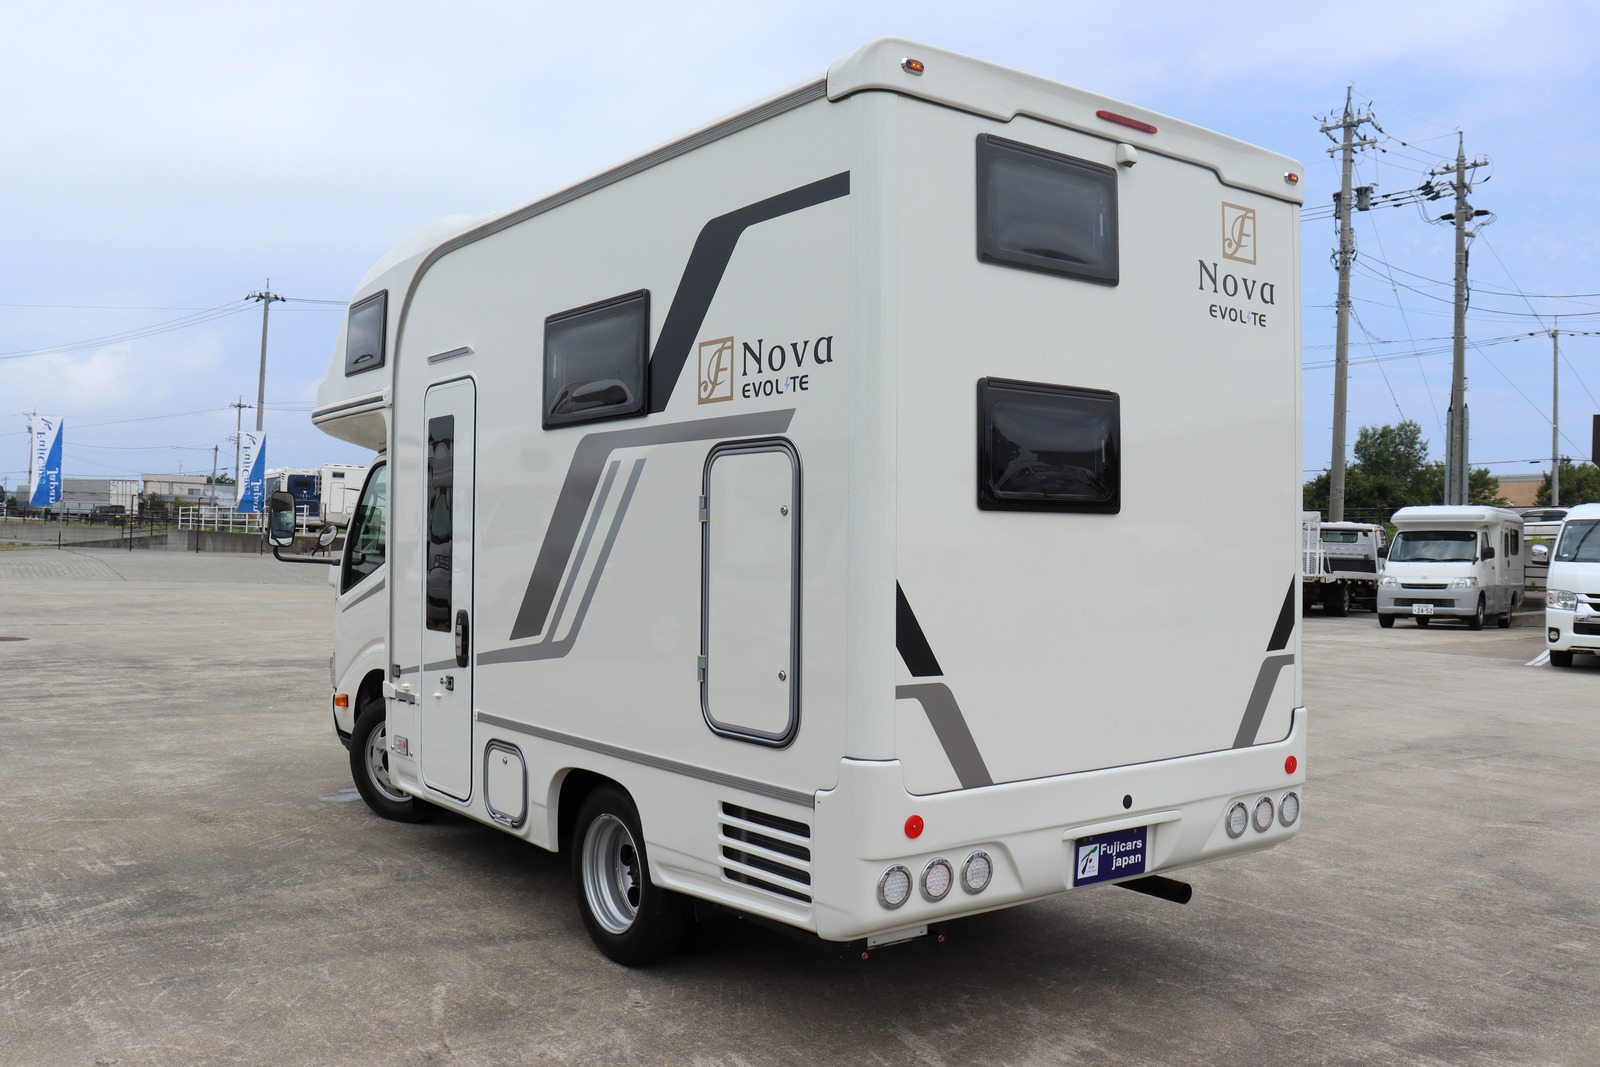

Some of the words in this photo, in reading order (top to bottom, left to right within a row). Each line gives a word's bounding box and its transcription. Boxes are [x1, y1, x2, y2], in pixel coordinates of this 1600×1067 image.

[1198, 260, 1274, 305] Nova
[742, 336, 833, 376] Nova
[1100, 840, 1142, 856] Fujicars
[1112, 854, 1141, 870] japan
